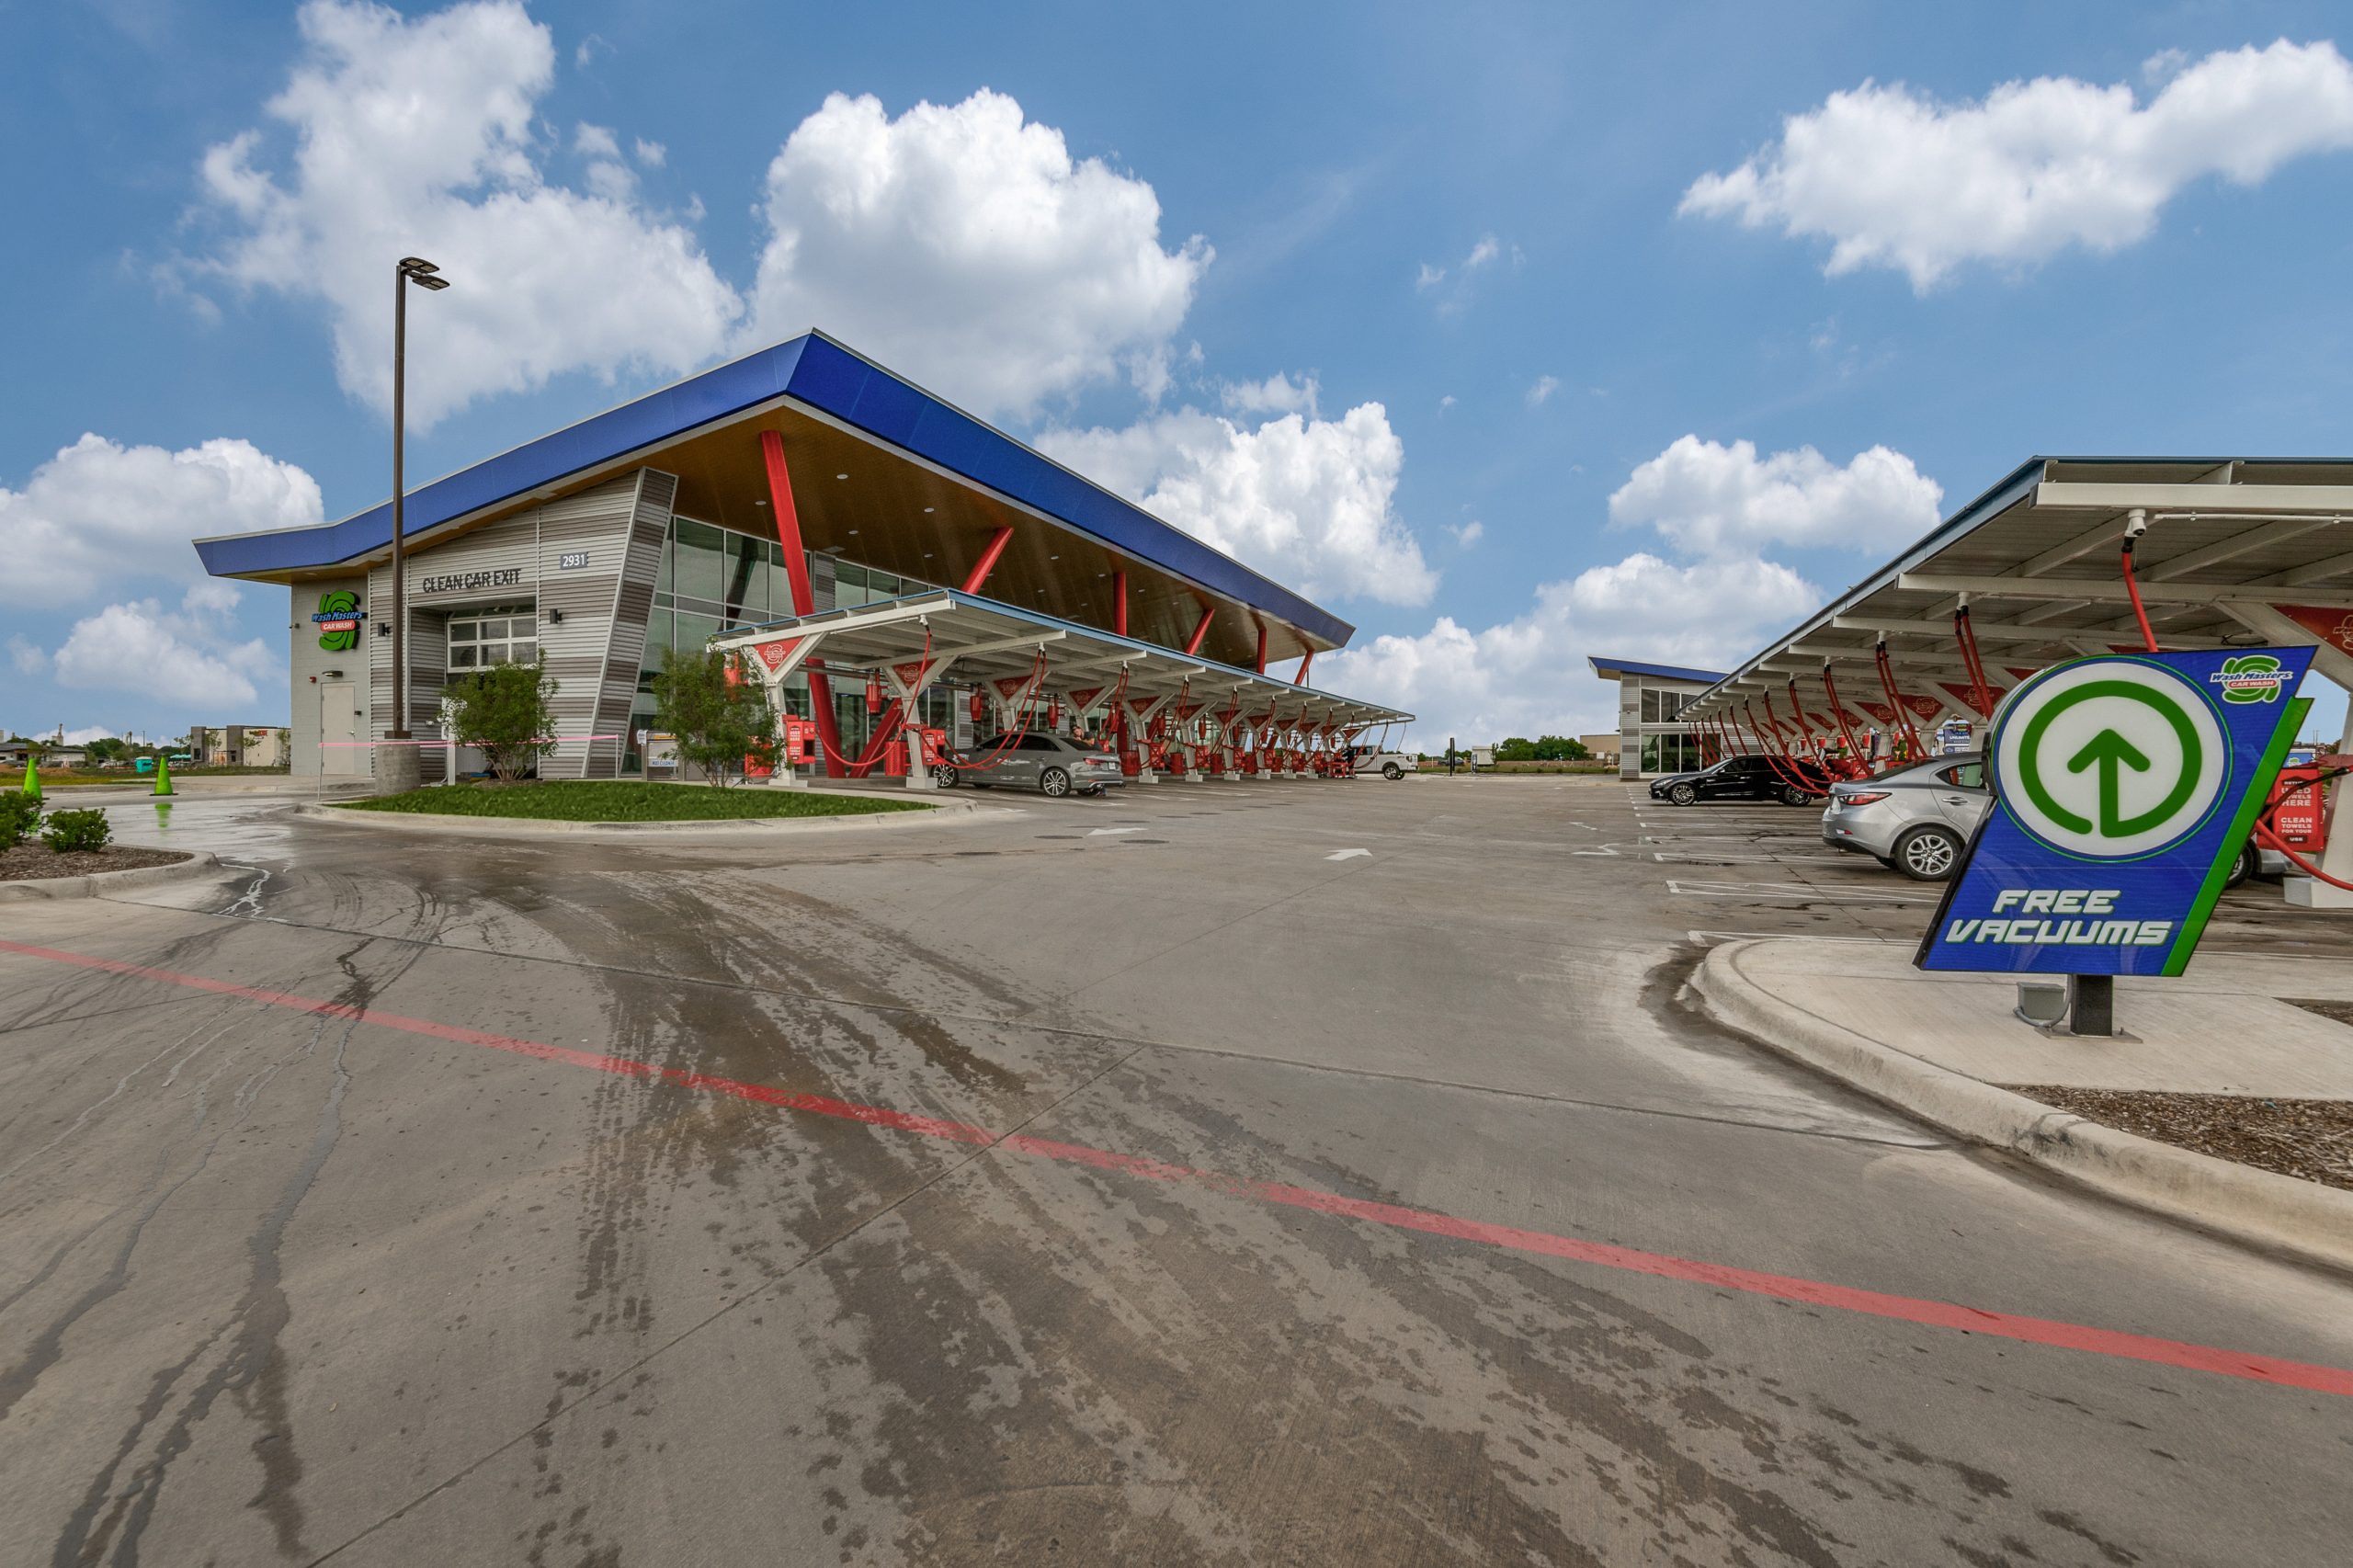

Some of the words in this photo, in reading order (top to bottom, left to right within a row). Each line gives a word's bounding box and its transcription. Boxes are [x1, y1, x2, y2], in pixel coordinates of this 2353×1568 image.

[563, 554, 585, 567] 2931
[423, 574, 462, 593] CLEAN
[465, 572, 490, 588] CAR
[494, 568, 521, 586] EXIT
[312, 613, 331, 622] Wash
[332, 611, 362, 620] Masters
[2211, 673, 2242, 681] Wash
[2244, 672, 2290, 680] Masters
[1992, 890, 2121, 914] FREE
[1944, 919, 2174, 945] VACUUMS
